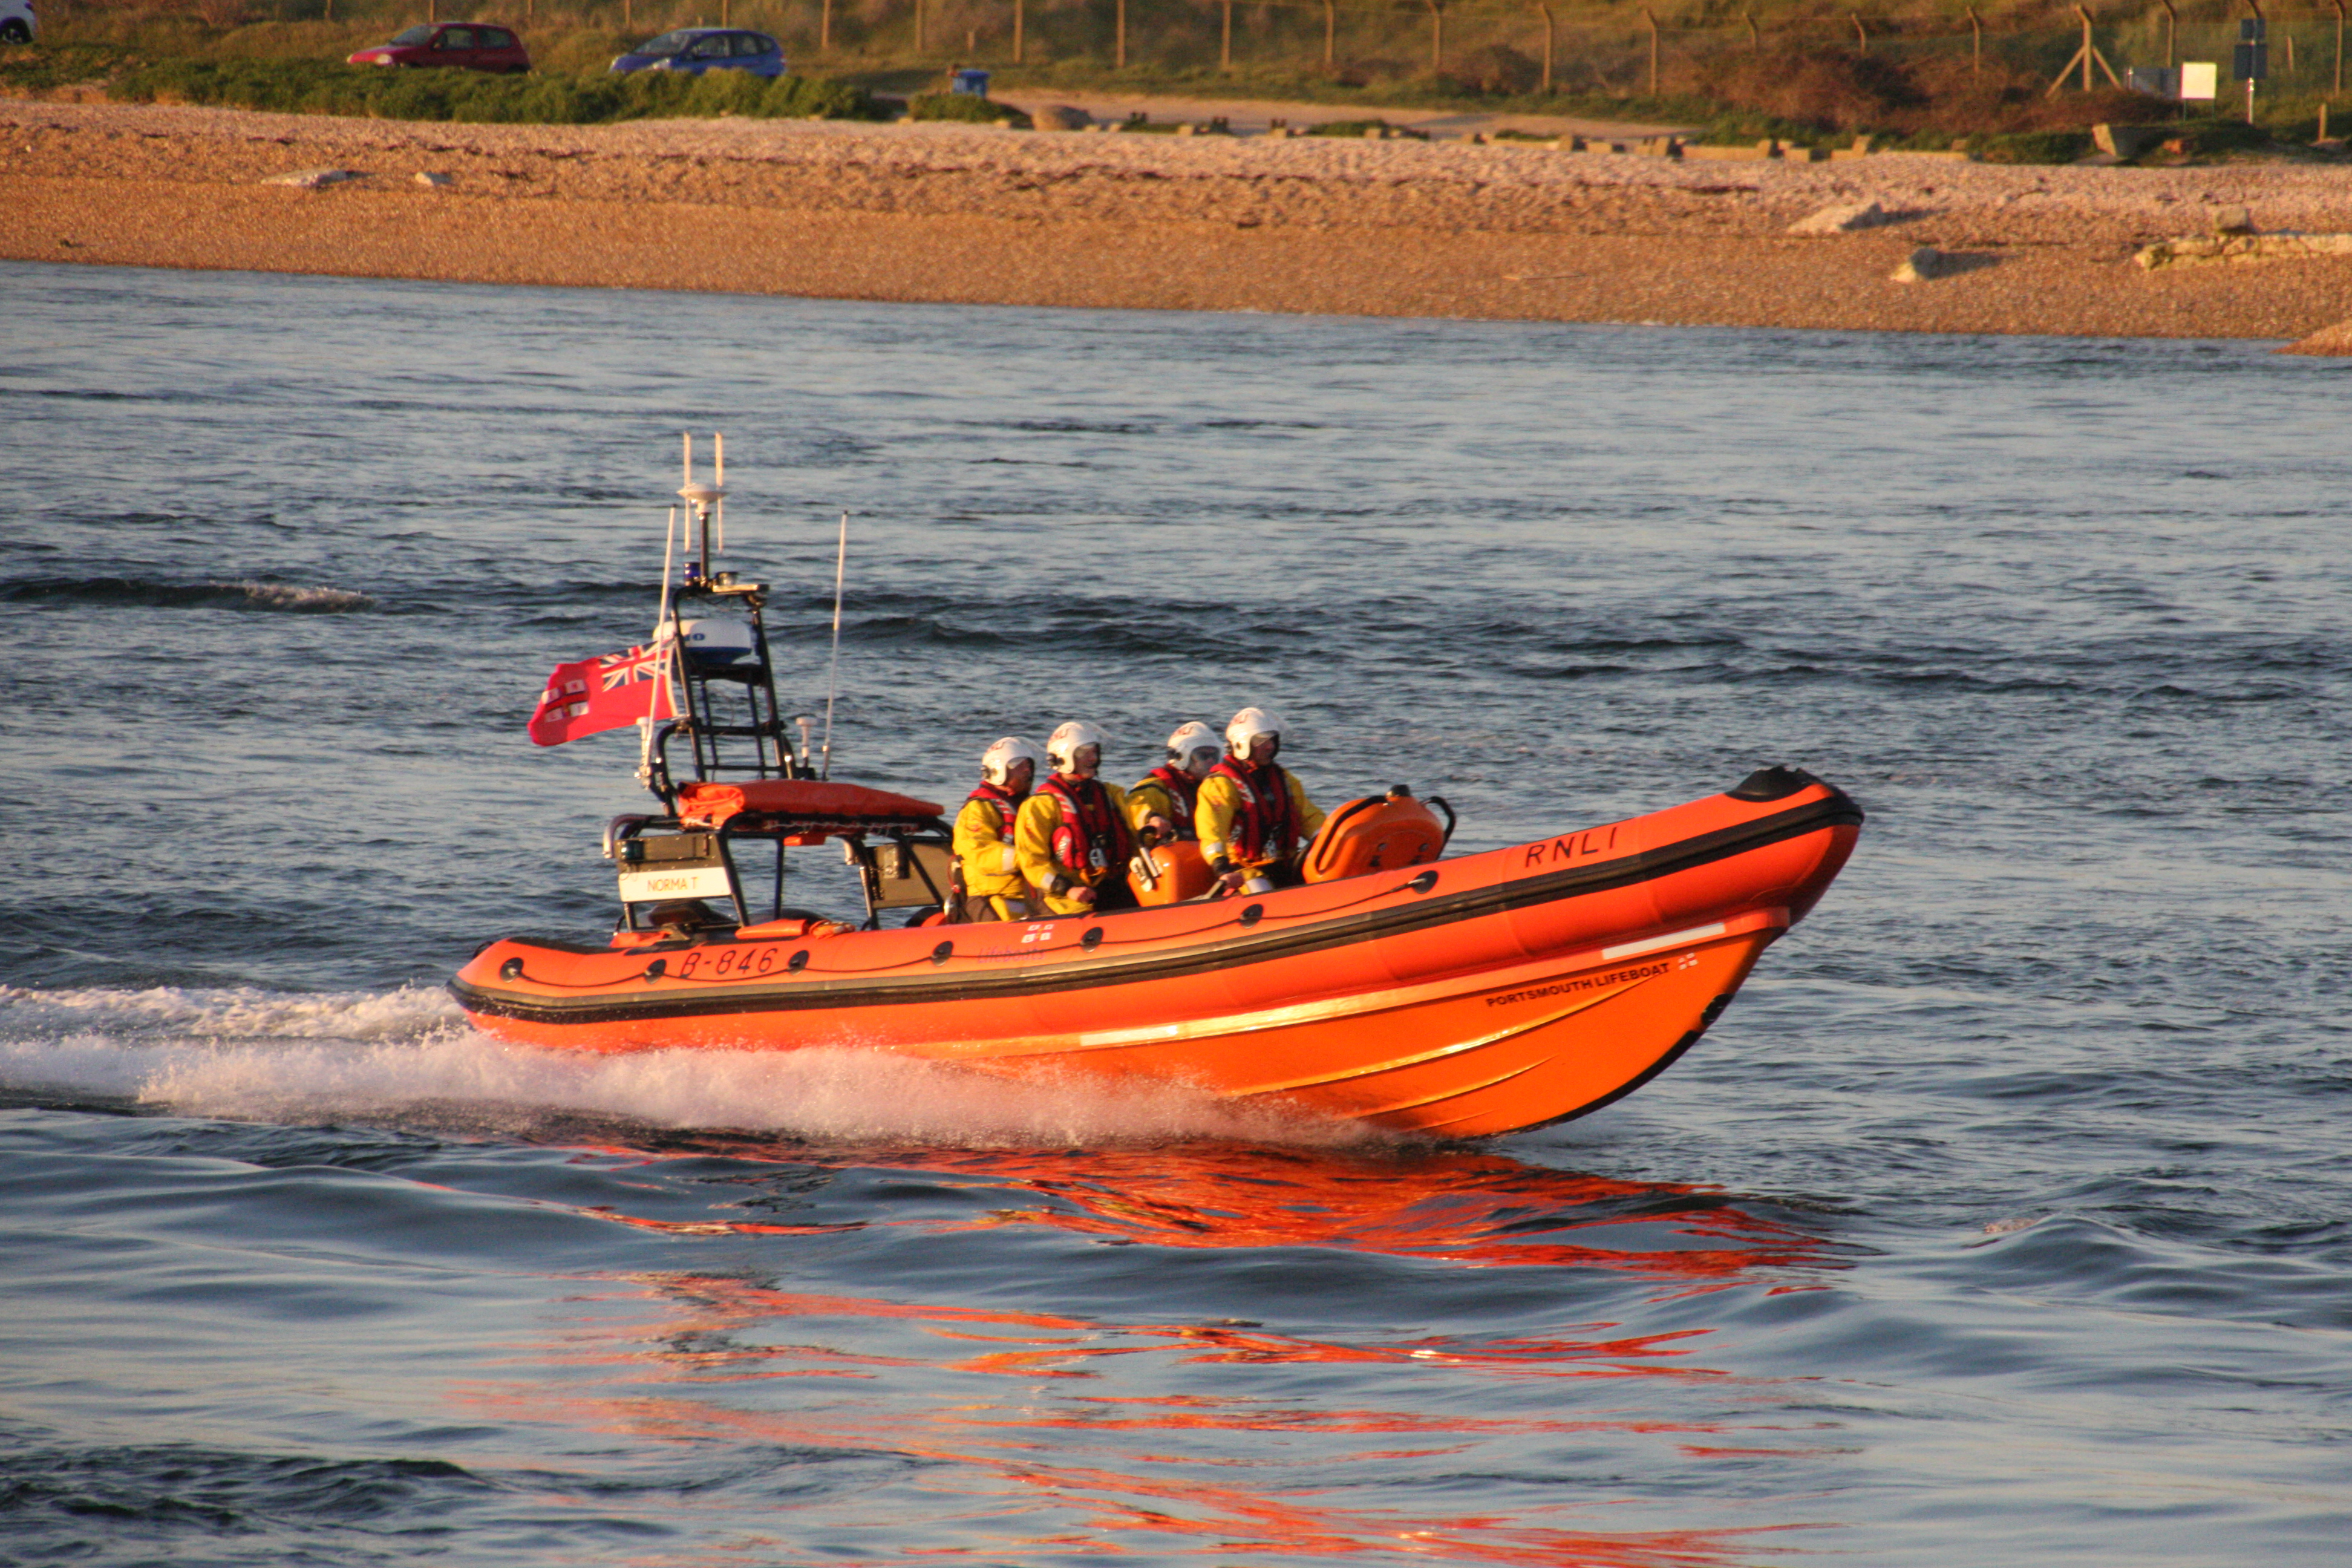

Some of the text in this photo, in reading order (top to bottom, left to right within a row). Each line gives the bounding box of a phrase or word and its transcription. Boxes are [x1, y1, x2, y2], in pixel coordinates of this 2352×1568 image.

[1524, 826, 1618, 868] RNLI
[647, 877, 698, 892] NORMA T
[679, 947, 779, 979] B-846
[1486, 962, 1670, 1007] PORTSMOUTH LIFEBOAT
